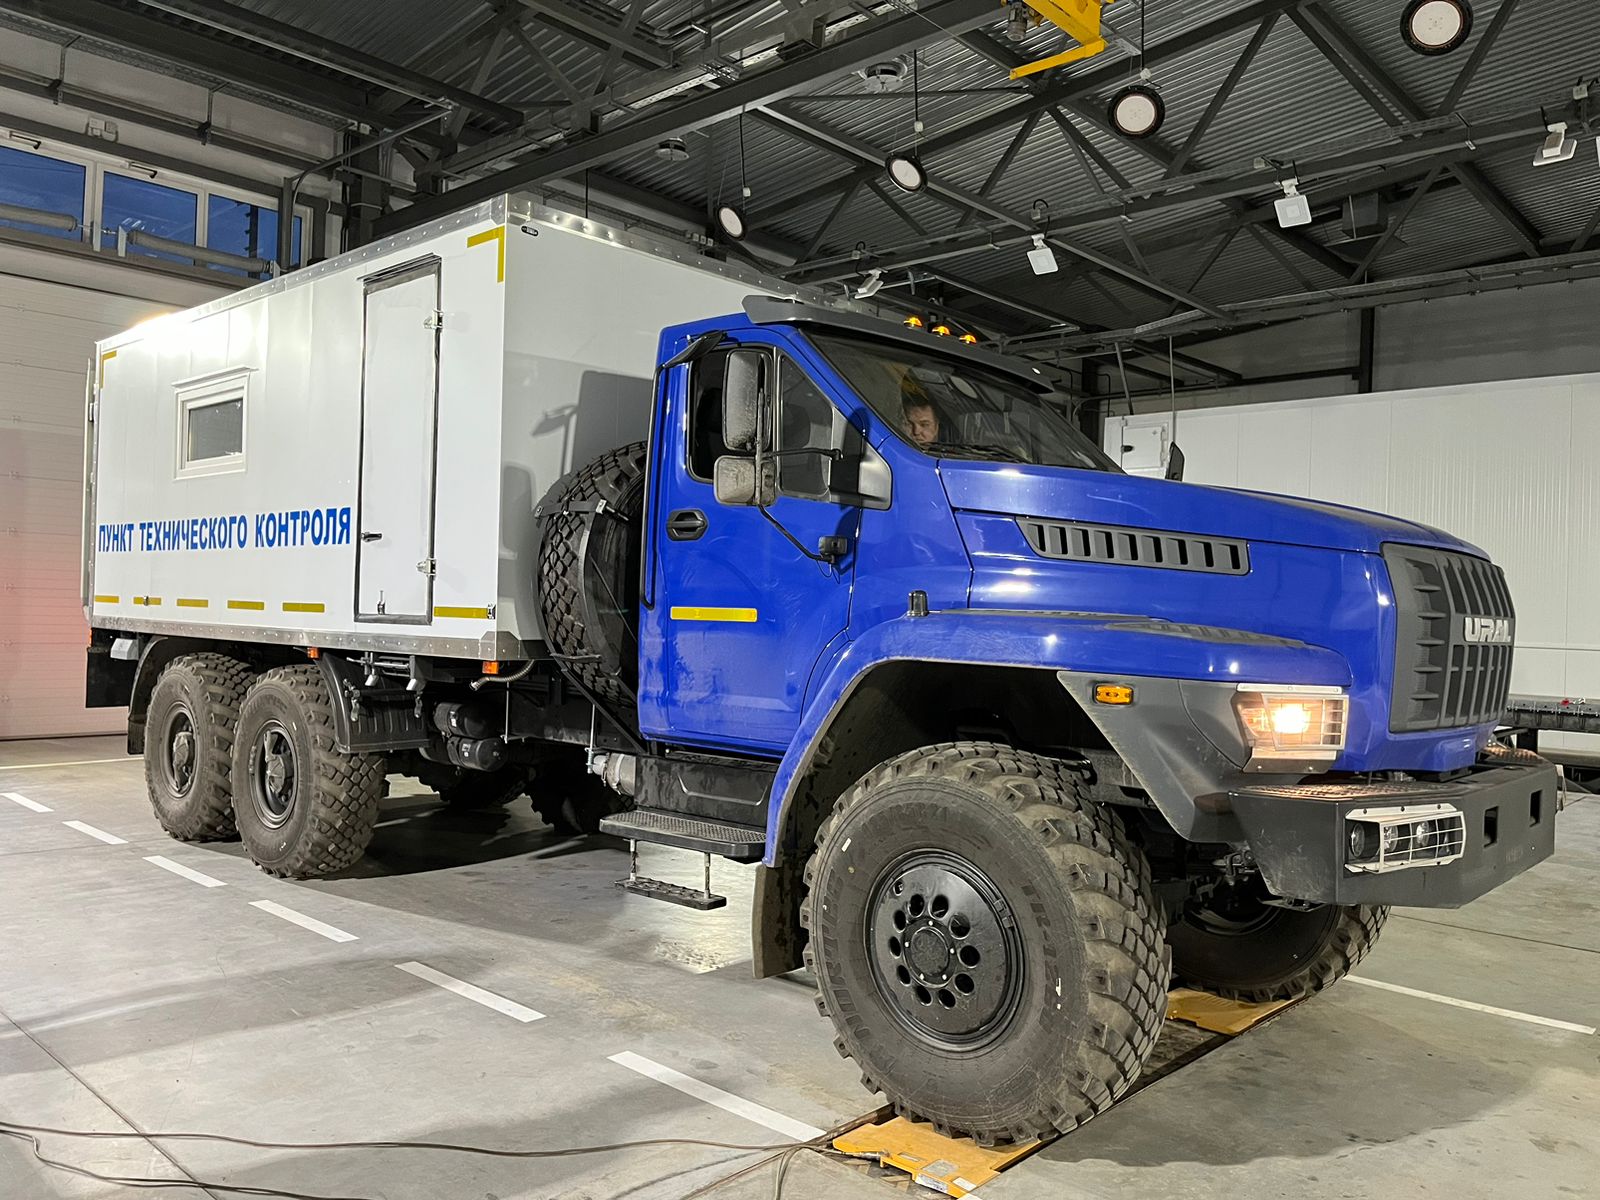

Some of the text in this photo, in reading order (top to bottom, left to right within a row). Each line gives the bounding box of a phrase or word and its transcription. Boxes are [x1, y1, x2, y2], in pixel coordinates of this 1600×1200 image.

[99, 506, 351, 552] ПУНКТ ТЕХНИЧЕСКОГО КОНТРОЛЯ
[1464, 617, 1511, 642] URAL
